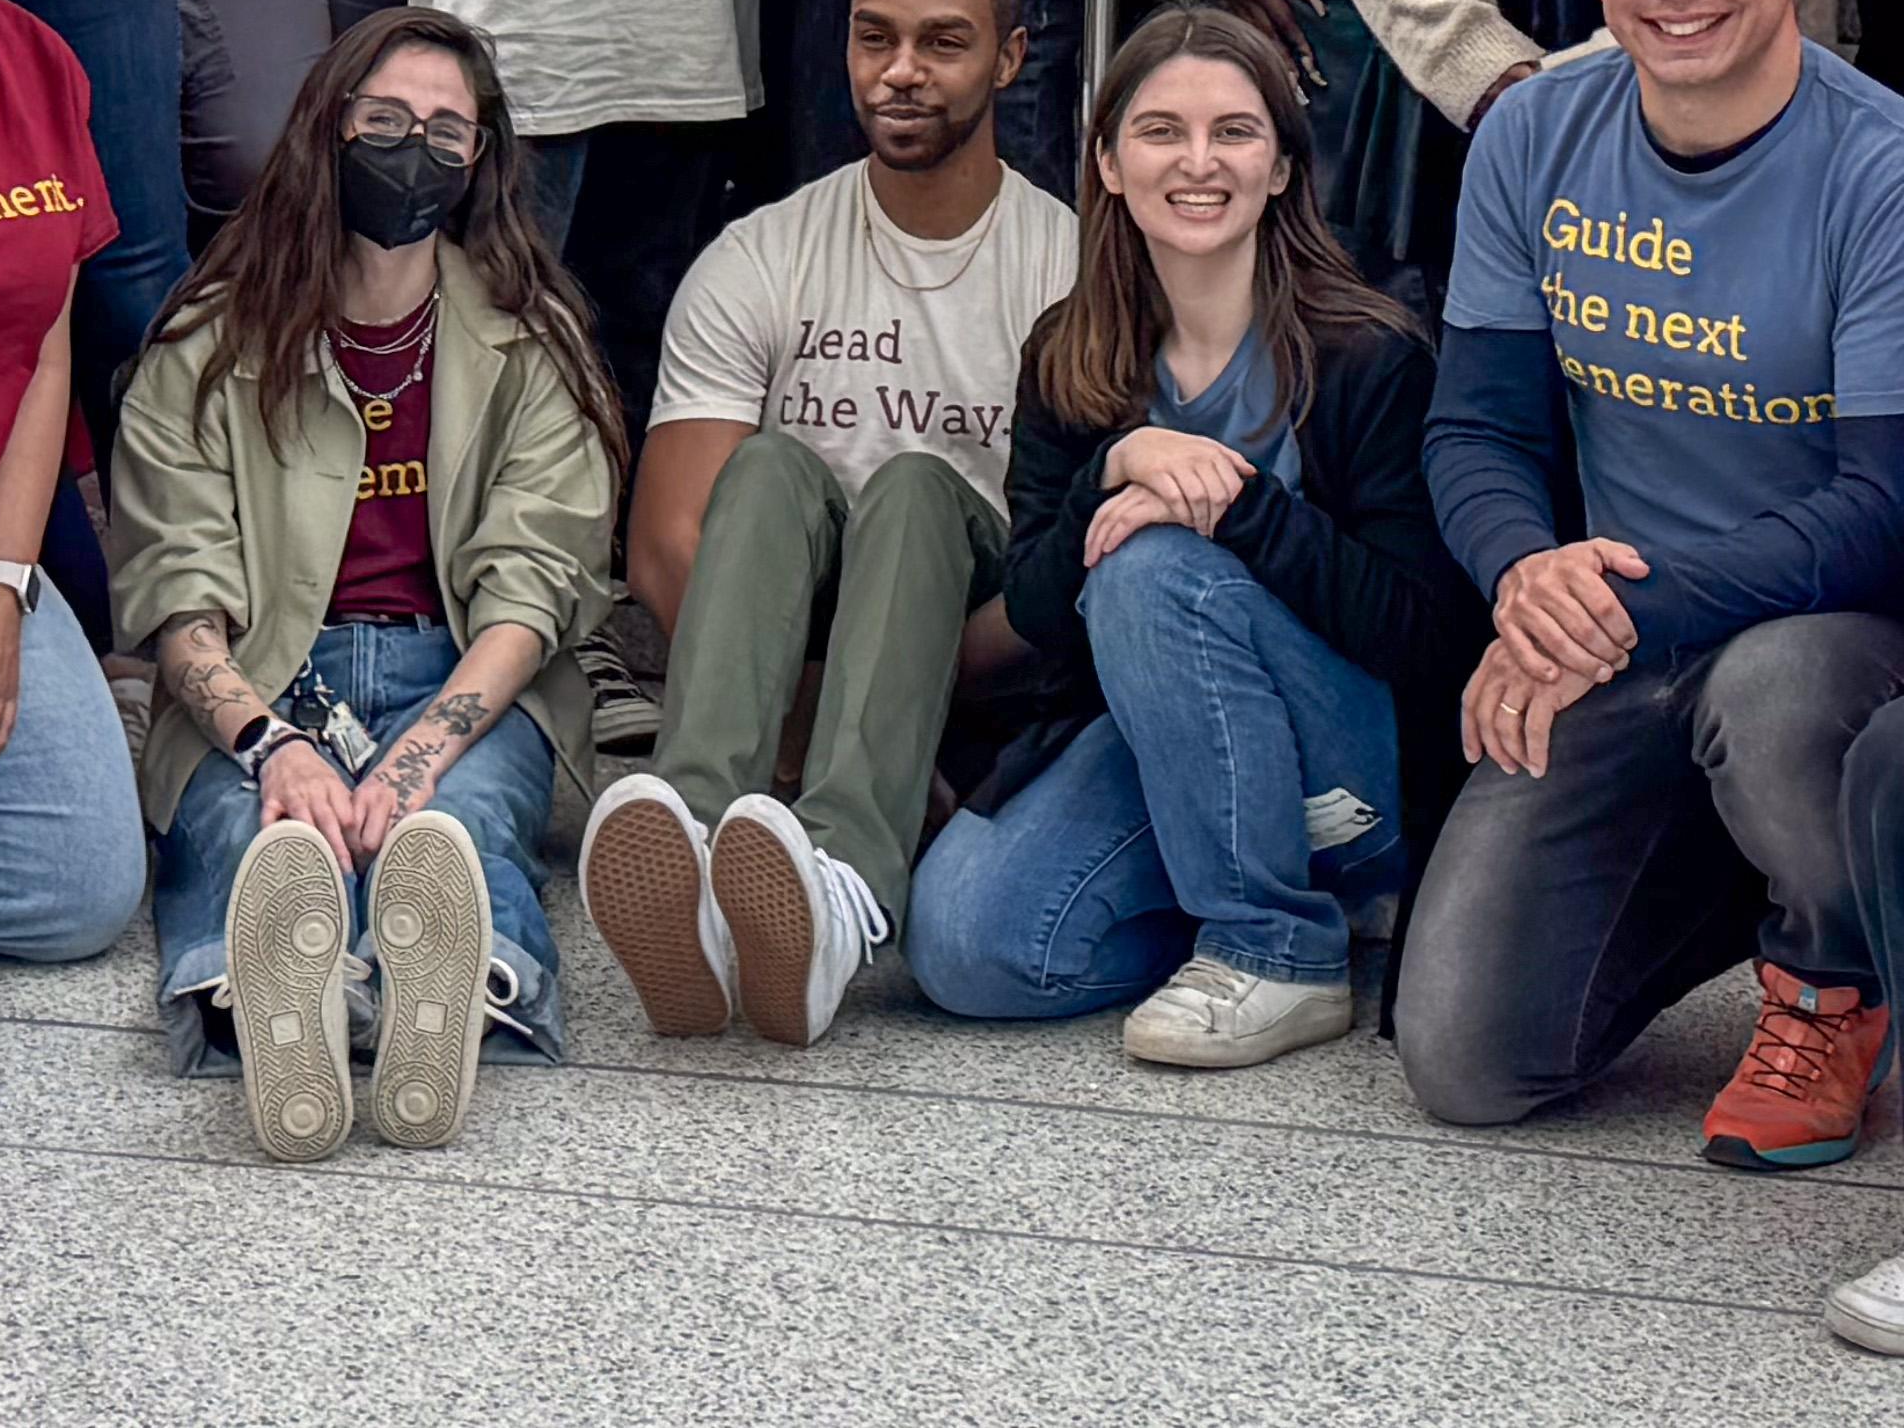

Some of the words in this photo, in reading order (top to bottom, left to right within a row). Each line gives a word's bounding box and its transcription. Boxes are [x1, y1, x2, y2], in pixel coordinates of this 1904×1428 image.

[1542, 198, 1693, 276] Guide
[796, 319, 903, 364] Lead
[1626, 302, 1748, 361] next
[781, 382, 858, 429] the
[876, 385, 1011, 448] Way.
[1555, 347, 1838, 424] eneration
